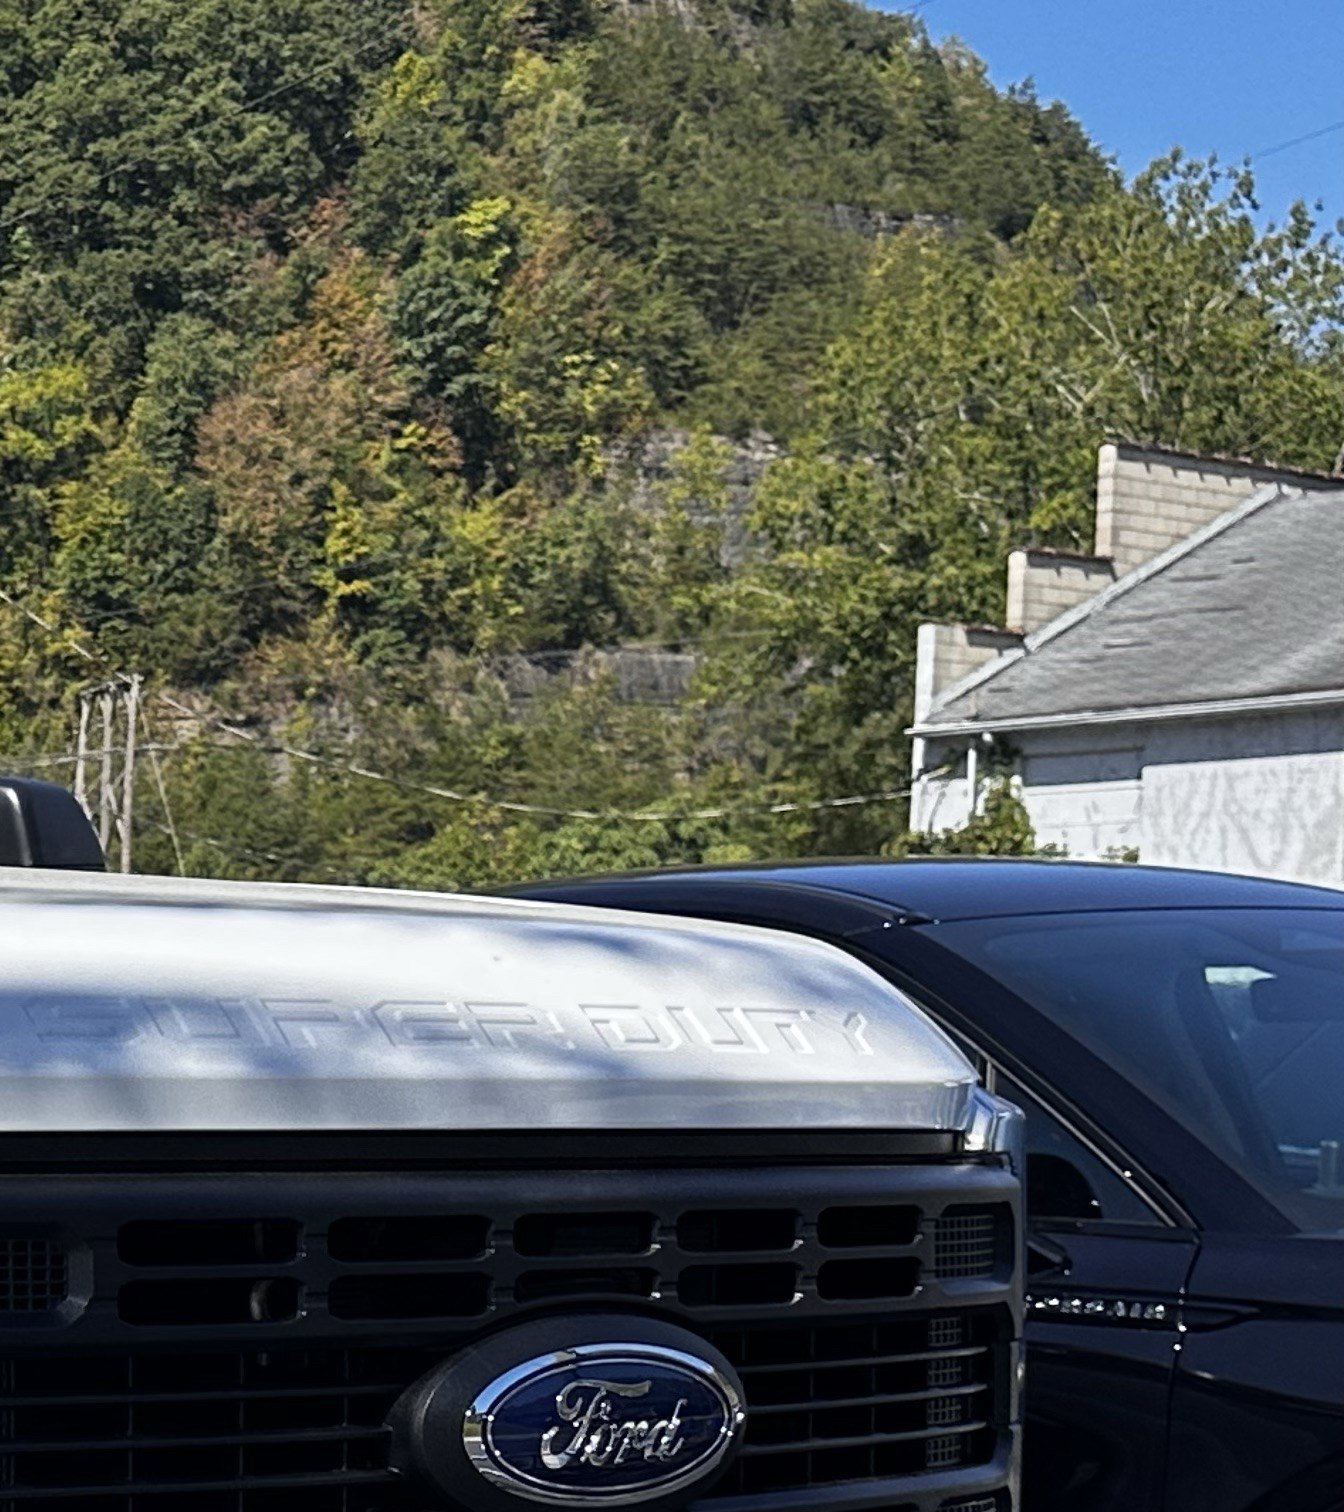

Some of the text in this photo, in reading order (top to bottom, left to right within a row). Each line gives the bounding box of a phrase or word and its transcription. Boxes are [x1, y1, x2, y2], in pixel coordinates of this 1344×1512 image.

[18, 997, 875, 1057] SUPER DUTY
[540, 1378, 689, 1470] Ford
